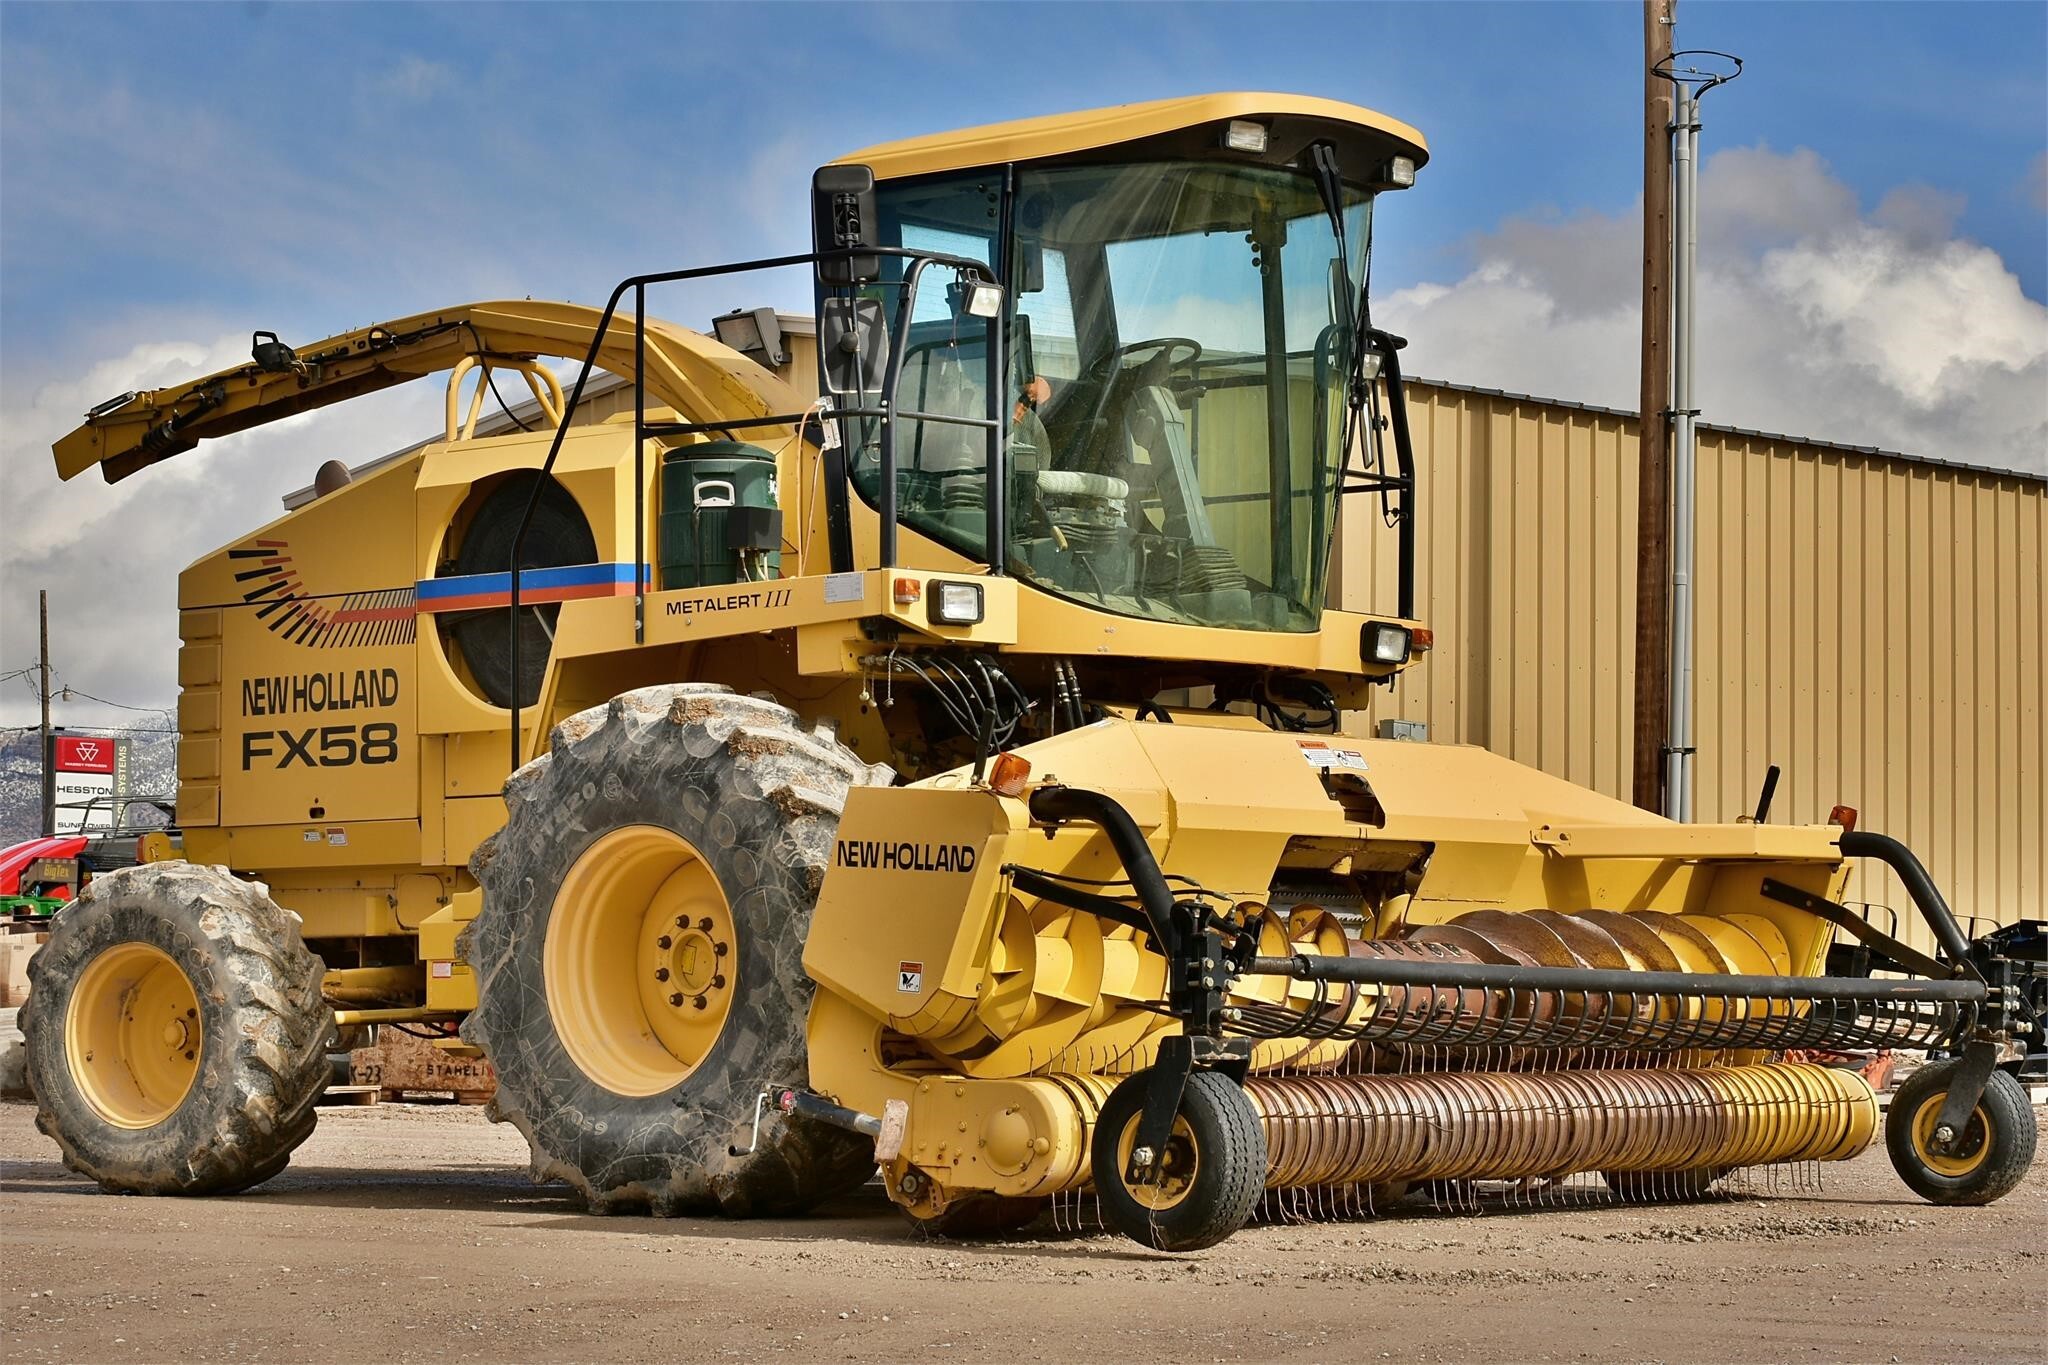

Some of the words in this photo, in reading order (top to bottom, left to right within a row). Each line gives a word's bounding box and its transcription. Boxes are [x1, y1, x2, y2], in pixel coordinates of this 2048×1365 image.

[666, 594, 761, 615] METALERT
[764, 589, 793, 608] III
[242, 676, 289, 717] NEW
[293, 668, 399, 713] HOLLAND
[242, 722, 398, 771] FX58
[57, 786, 112, 795] HESSTON
[837, 840, 880, 868] NEW
[883, 842, 976, 873] HOLLAND
[350, 1065, 382, 1083] K-23
[427, 1064, 485, 1077] STAHELI
